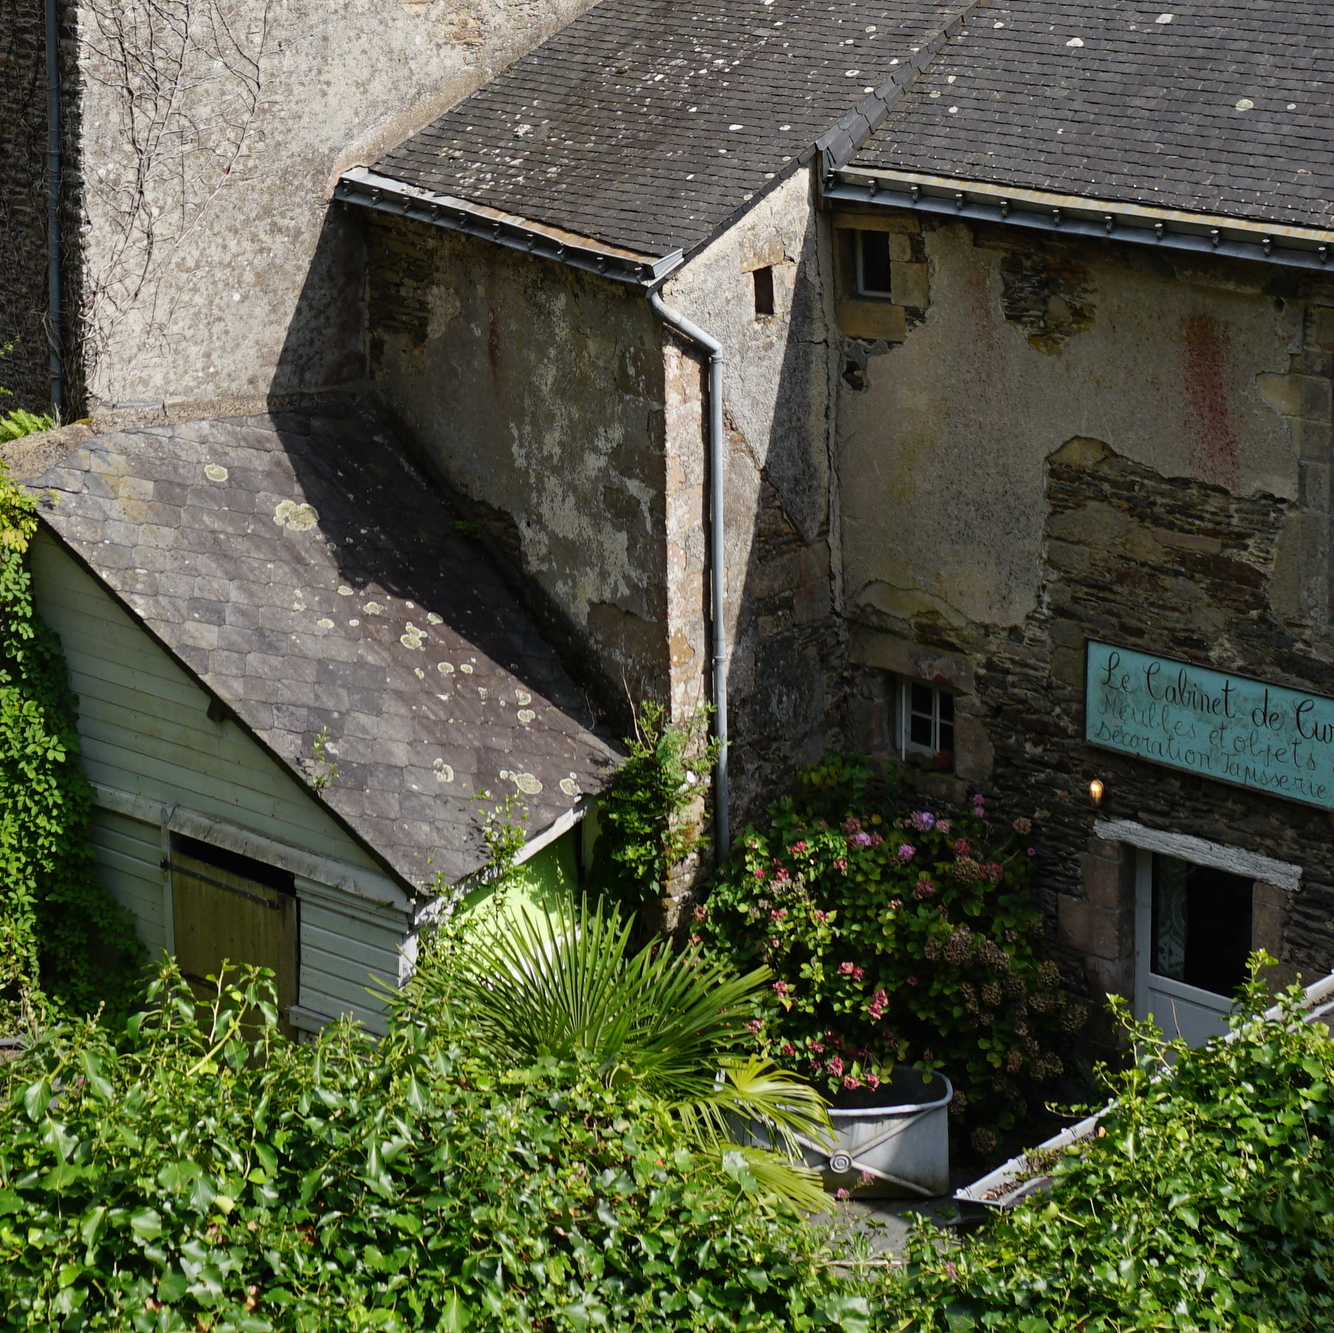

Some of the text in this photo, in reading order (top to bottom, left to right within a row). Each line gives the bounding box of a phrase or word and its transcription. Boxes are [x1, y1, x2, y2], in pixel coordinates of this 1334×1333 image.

[1100, 651, 1135, 693] Le
[1143, 662, 1236, 718] Cabinet
[1252, 688, 1283, 731] de
[1095, 722, 1212, 770] Décoration
[1221, 752, 1327, 799] Tapisserie
[1098, 694, 1196, 739] Meubles
[1209, 721, 1227, 748] et
[1234, 729, 1315, 771] objets
